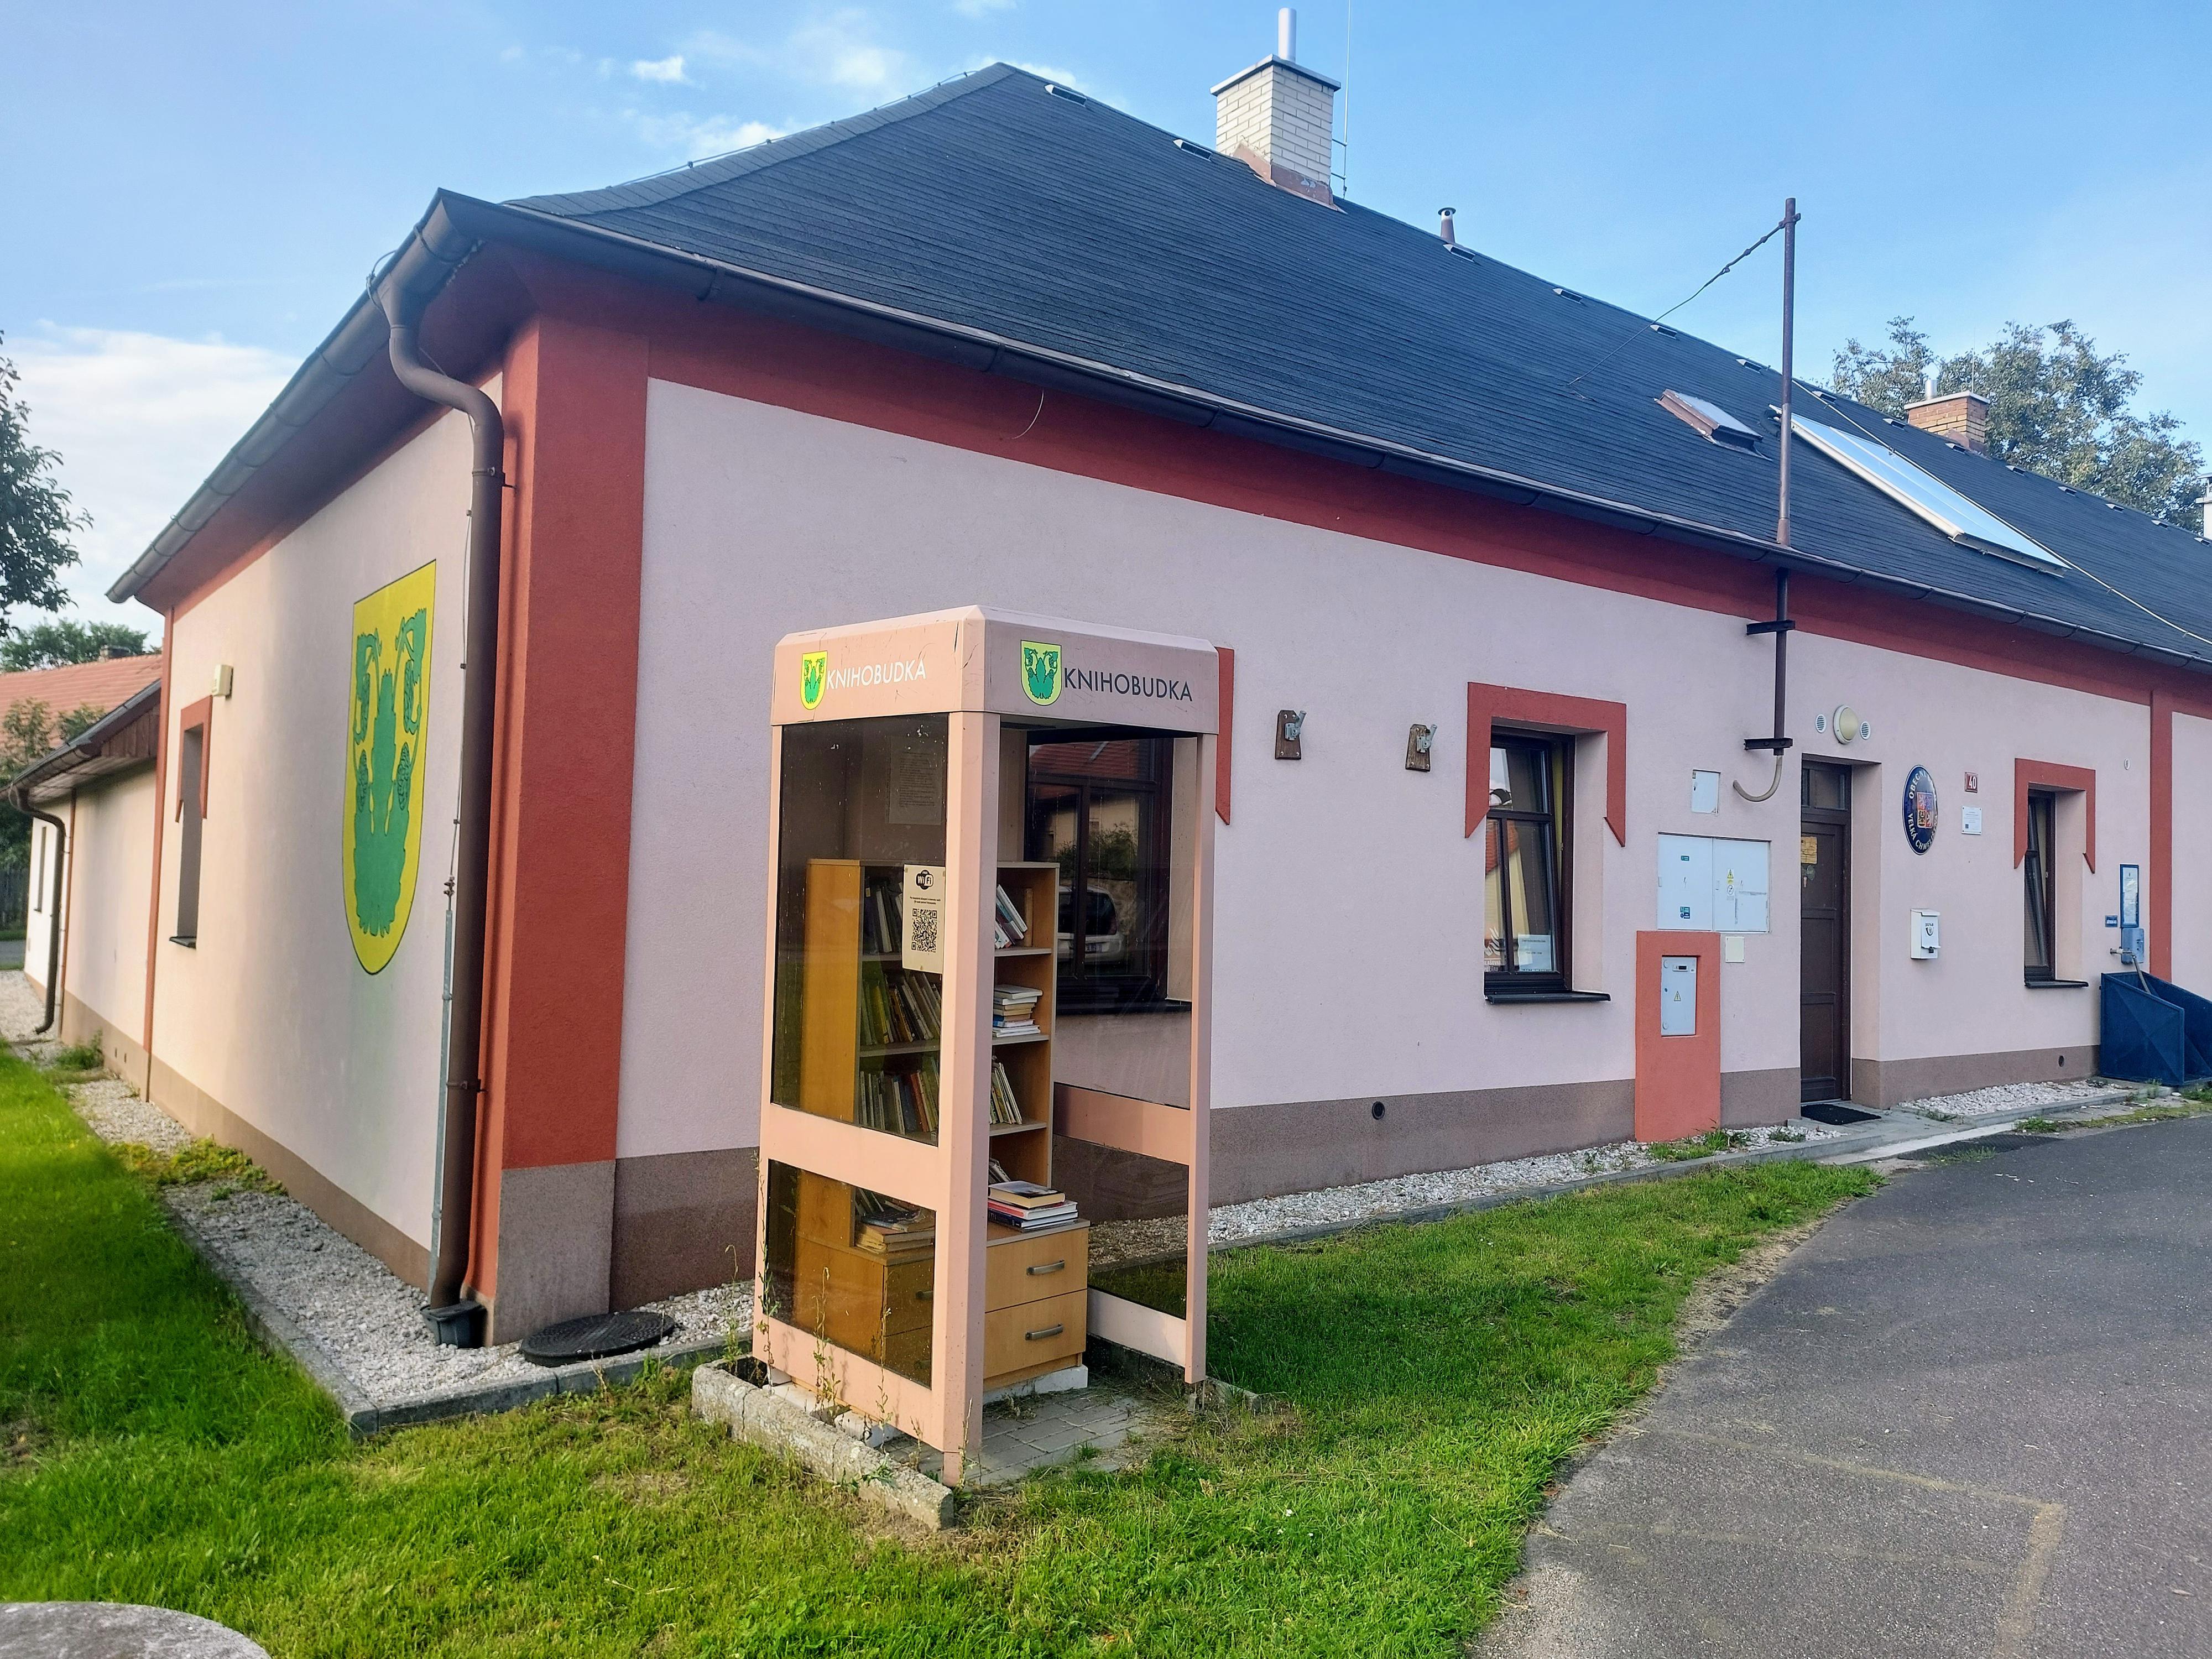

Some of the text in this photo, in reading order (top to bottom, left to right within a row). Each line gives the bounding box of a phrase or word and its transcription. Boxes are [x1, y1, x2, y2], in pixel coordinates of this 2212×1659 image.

[827, 658, 926, 690] KNIHOBUDKA
[1065, 667, 1193, 702] KNIHOBUDKA
[1969, 775, 1977, 789] 40
[1907, 813, 1918, 841] VELKÁ
